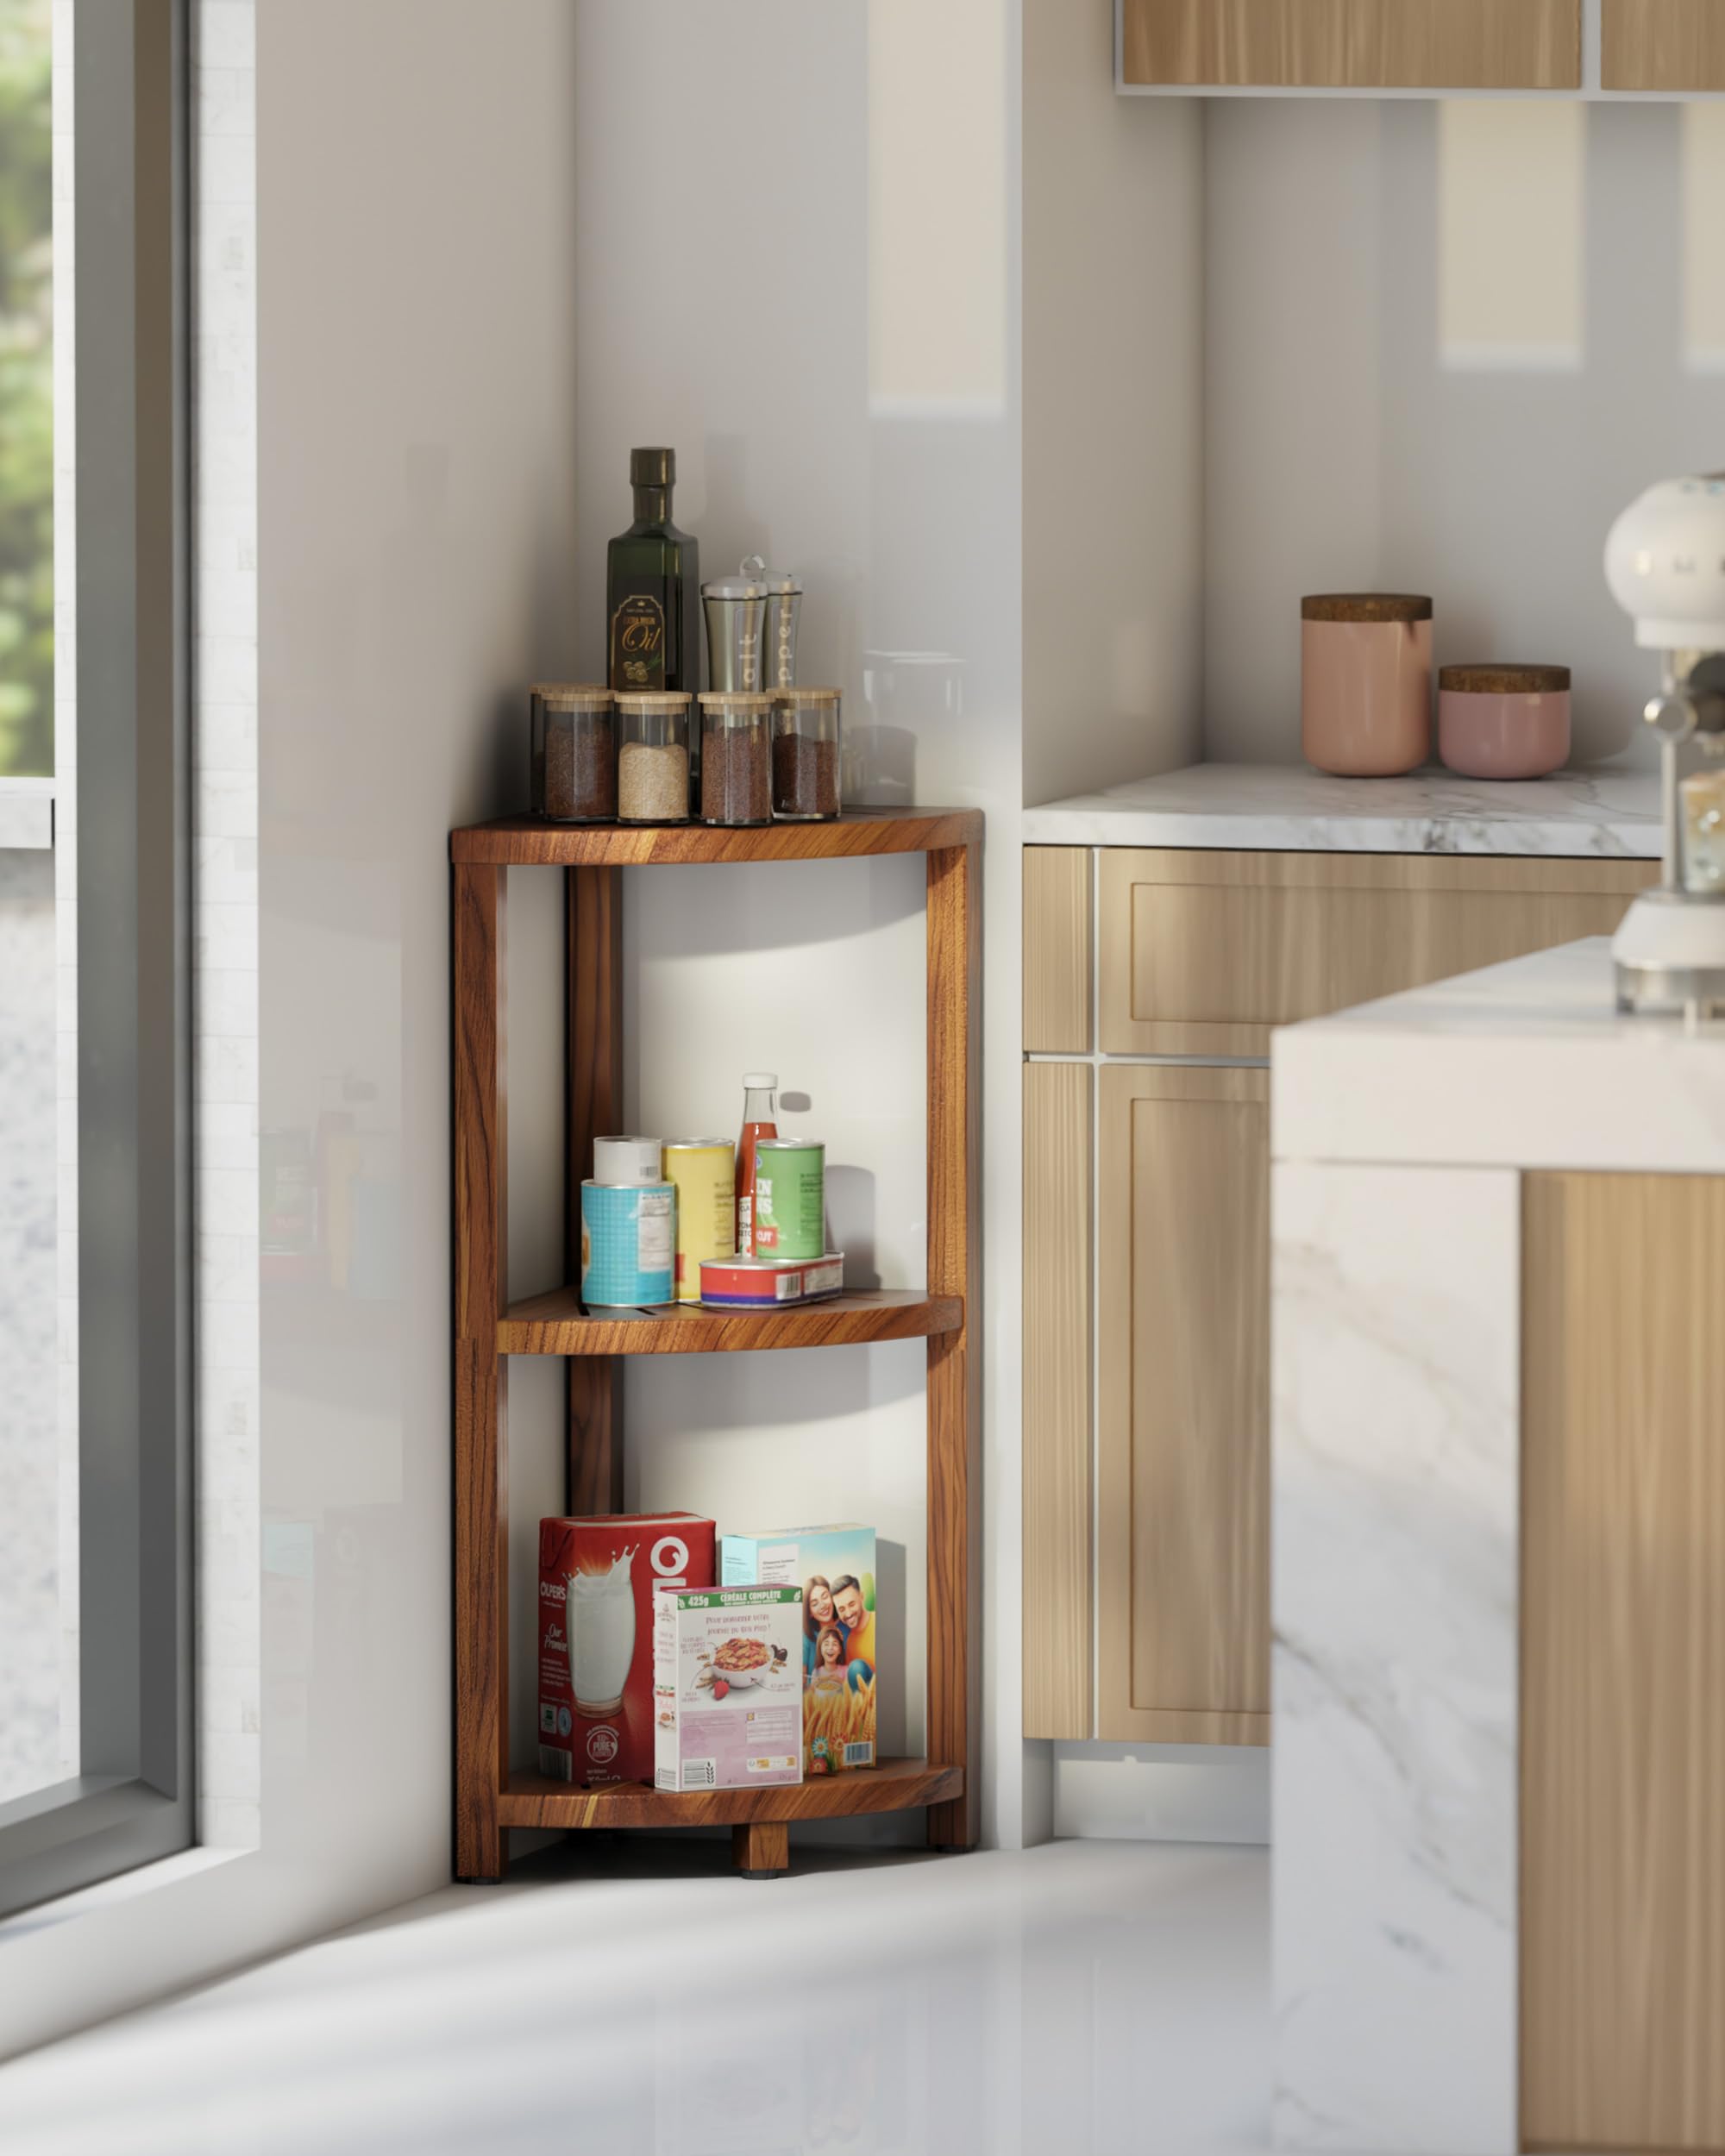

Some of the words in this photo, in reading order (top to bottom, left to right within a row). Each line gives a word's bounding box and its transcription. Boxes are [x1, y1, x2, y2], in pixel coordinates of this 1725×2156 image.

[622, 621, 662, 652] Oil
[778, 608, 793, 681] pper
[738, 634, 756, 684] alt
[688, 1595, 709, 1607] 425g
